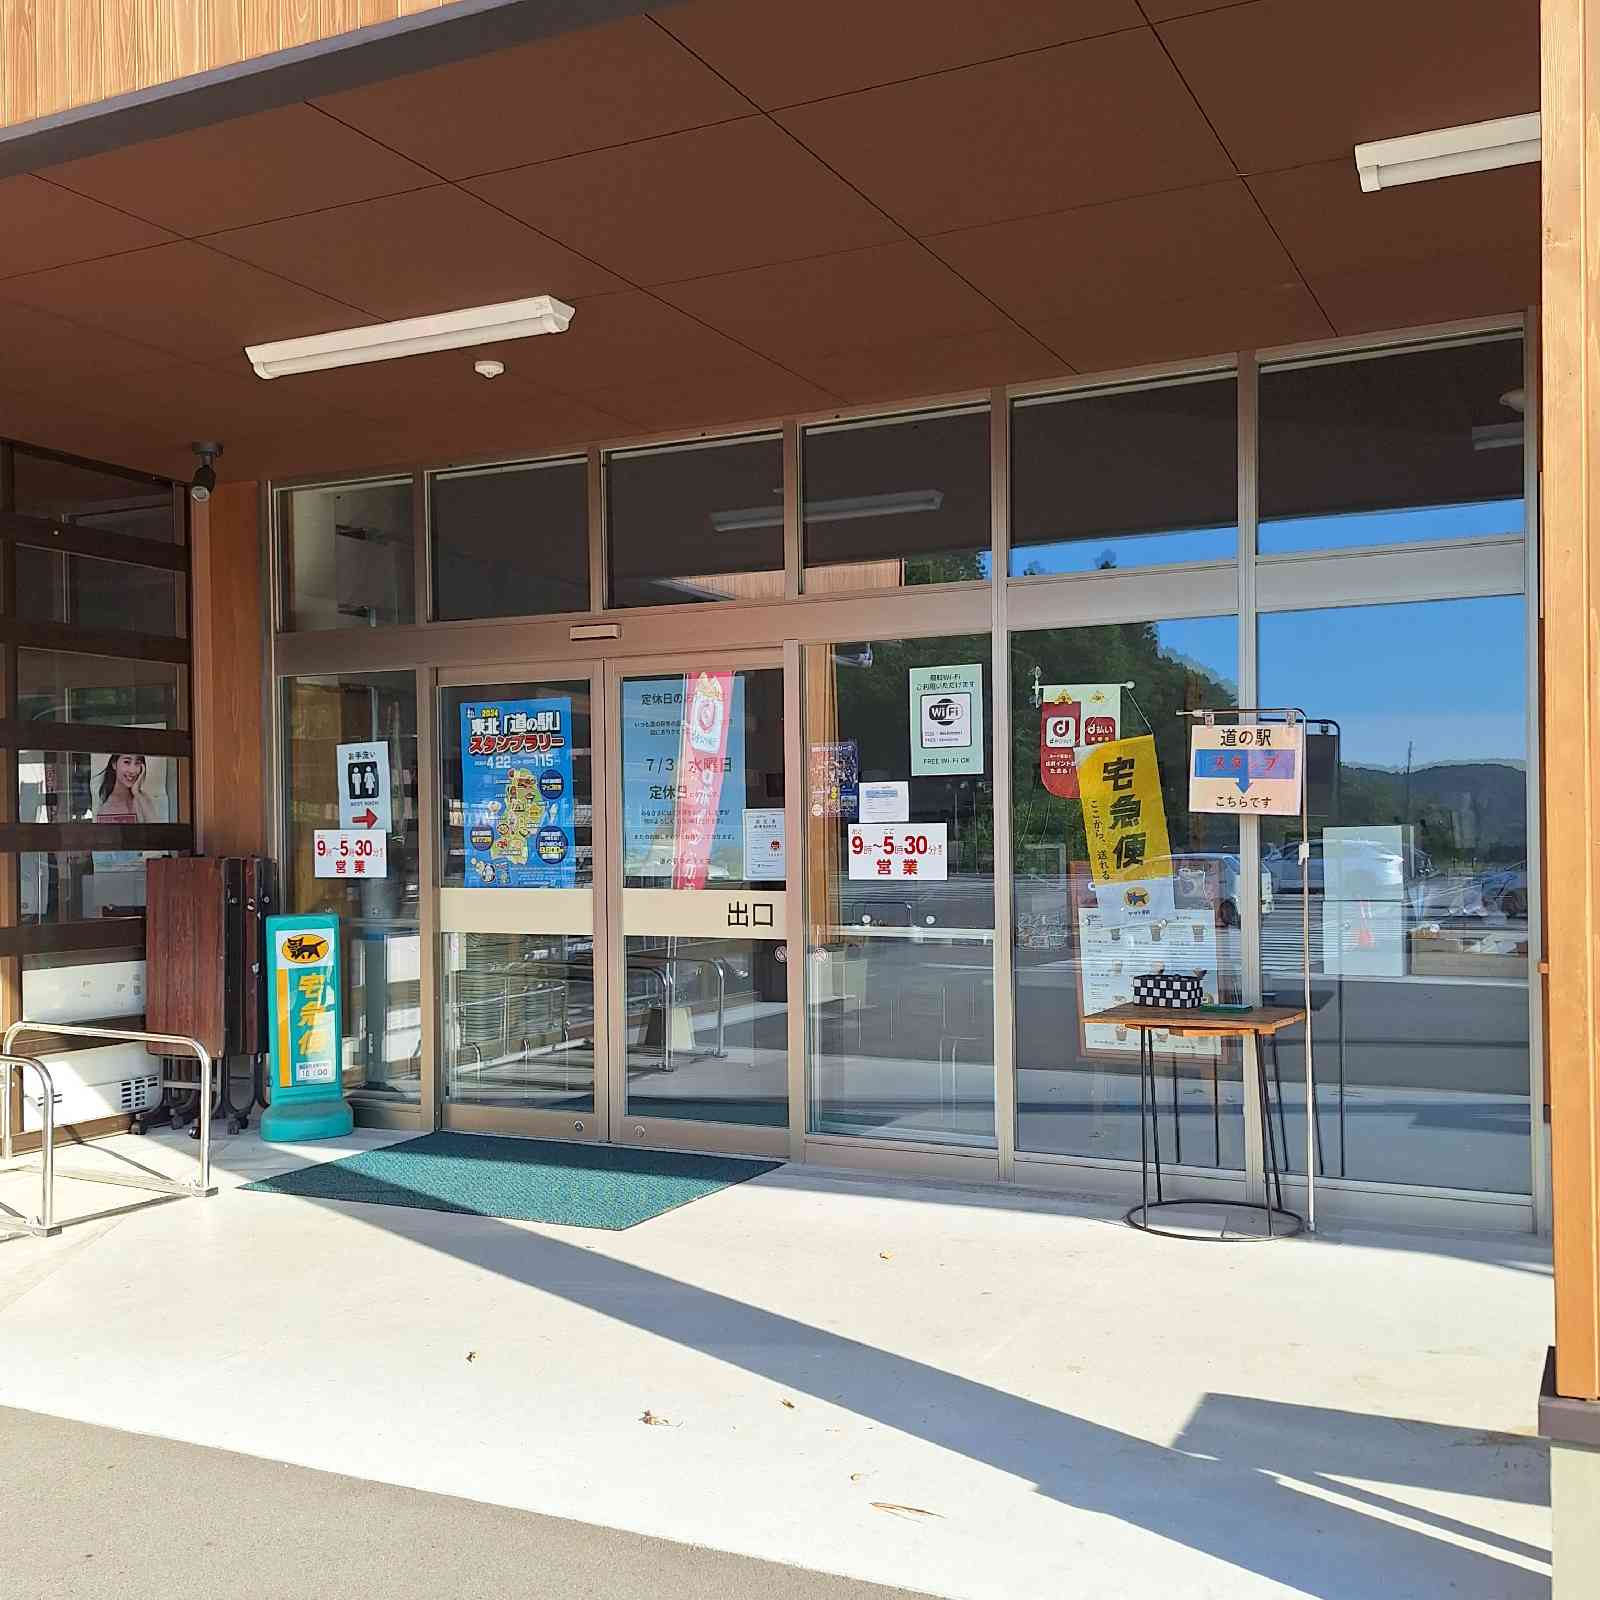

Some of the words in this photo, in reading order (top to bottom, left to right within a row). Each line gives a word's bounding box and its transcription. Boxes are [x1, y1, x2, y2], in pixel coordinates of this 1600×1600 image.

[1087, 724, 1114, 735] d払い
[1220, 729, 1271, 746] 道の駅
[469, 733, 565, 754] スタンプラリー
[348, 751, 376, 760] お手洗い
[649, 785, 688, 800] 定休日
[1216, 796, 1272, 808] こちらです
[1102, 757, 1148, 869] 宅急便
[728, 901, 773, 927] 出口
